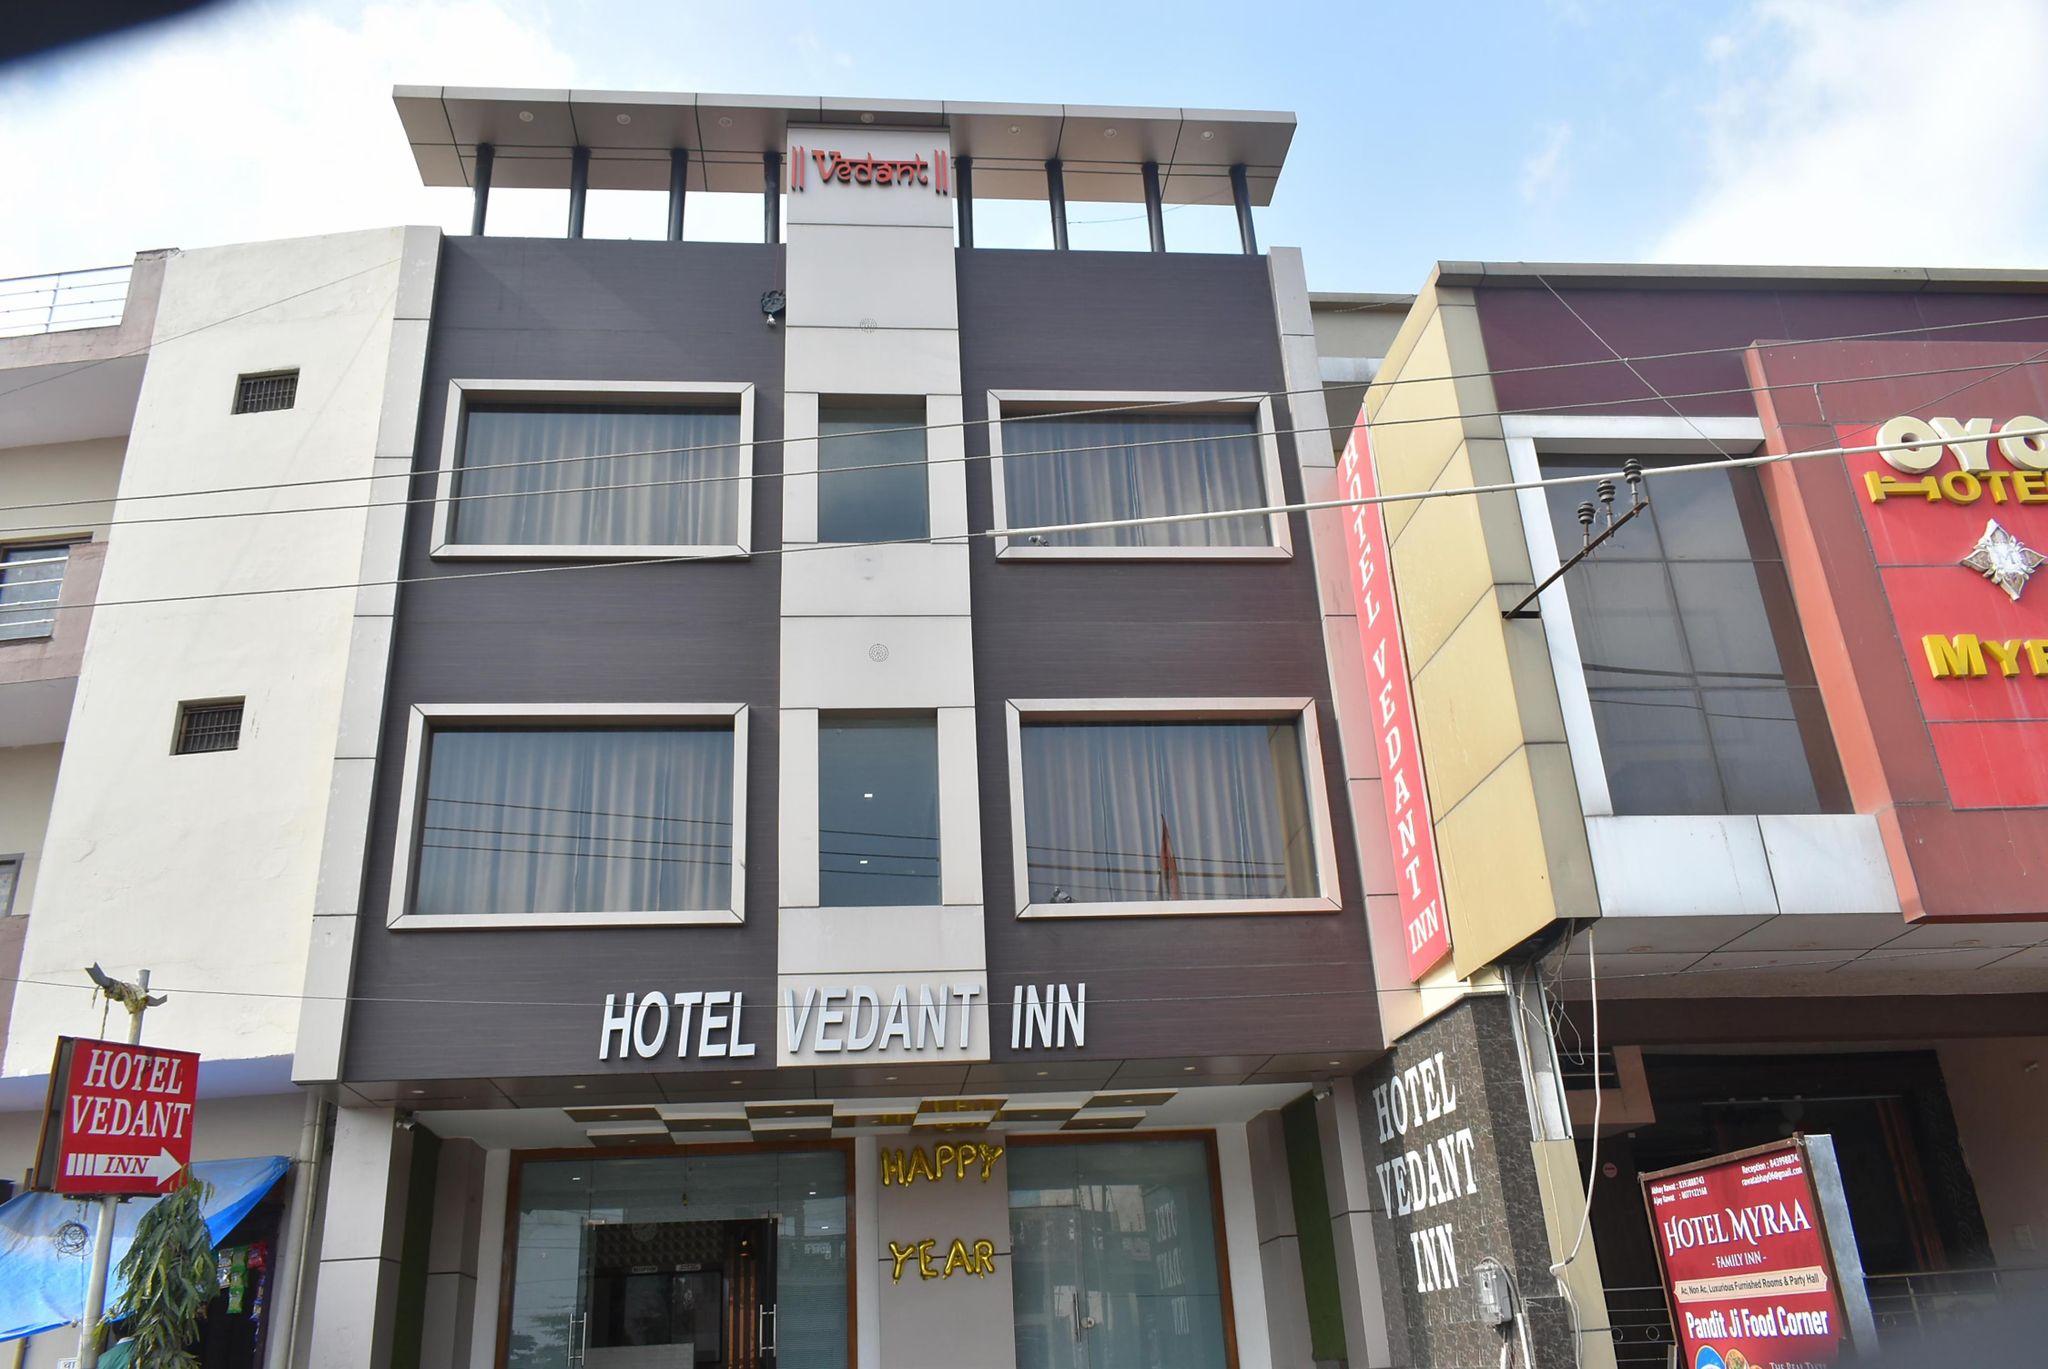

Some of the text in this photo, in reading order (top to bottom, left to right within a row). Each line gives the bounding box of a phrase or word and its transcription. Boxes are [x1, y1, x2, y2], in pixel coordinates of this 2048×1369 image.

[812, 150, 928, 186] Vedant
[1876, 415, 2048, 474] OYO
[1864, 470, 2048, 505] HOTE
[1345, 430, 1440, 955] HOTEL VEDANT INN
[599, 982, 1086, 1061] HOTEL VEDANT INN
[84, 1048, 183, 1095] HOTEL
[70, 1095, 192, 1139] VEDANT
[1372, 1051, 1456, 1144] HOTEL
[103, 1156, 151, 1175] INN
[881, 1142, 1005, 1186] HAPPY
[1375, 1127, 1478, 1220] VEDANT
[1663, 1198, 1812, 1257] HOTEL MYRAA
[889, 1238, 995, 1283] YEAR
[1410, 1222, 1459, 1293] INN
[1715, 1253, 1744, 1269] FAMILY
[1745, 1251, 1762, 1265] INN
[1689, 1285, 1700, 1294] Non
[1708, 1280, 1735, 1293] Luxurious
[1734, 1278, 1762, 1291] Furnished
[1763, 1277, 1783, 1288] Rooms
[1789, 1275, 1806, 1287] Party
[1807, 1273, 1820, 1284] Hall
[1685, 1305, 1829, 1339] Pandit Ji Food Corner
